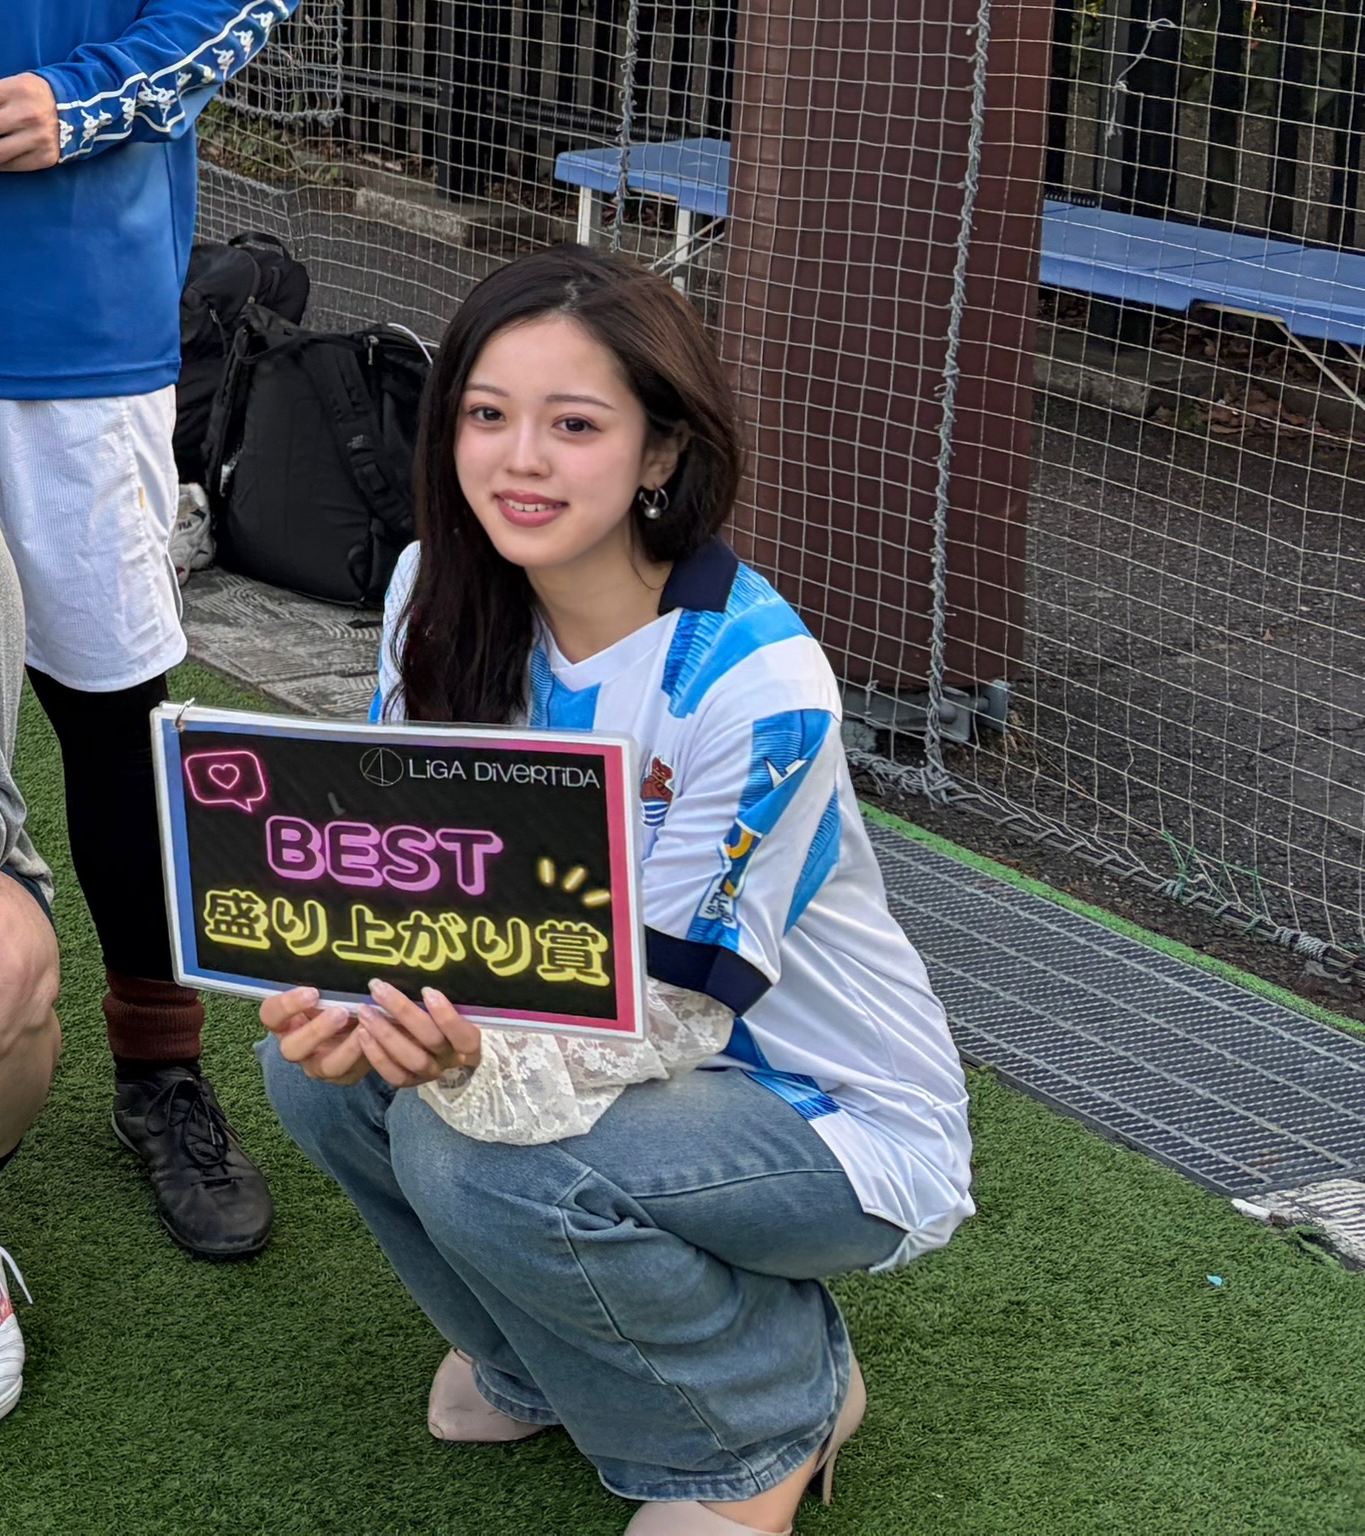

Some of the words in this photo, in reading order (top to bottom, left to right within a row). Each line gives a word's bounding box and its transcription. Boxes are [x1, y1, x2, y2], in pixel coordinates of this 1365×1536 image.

[265, 815, 504, 896] BEST
[203, 889, 611, 986] 盛り上がり賞
